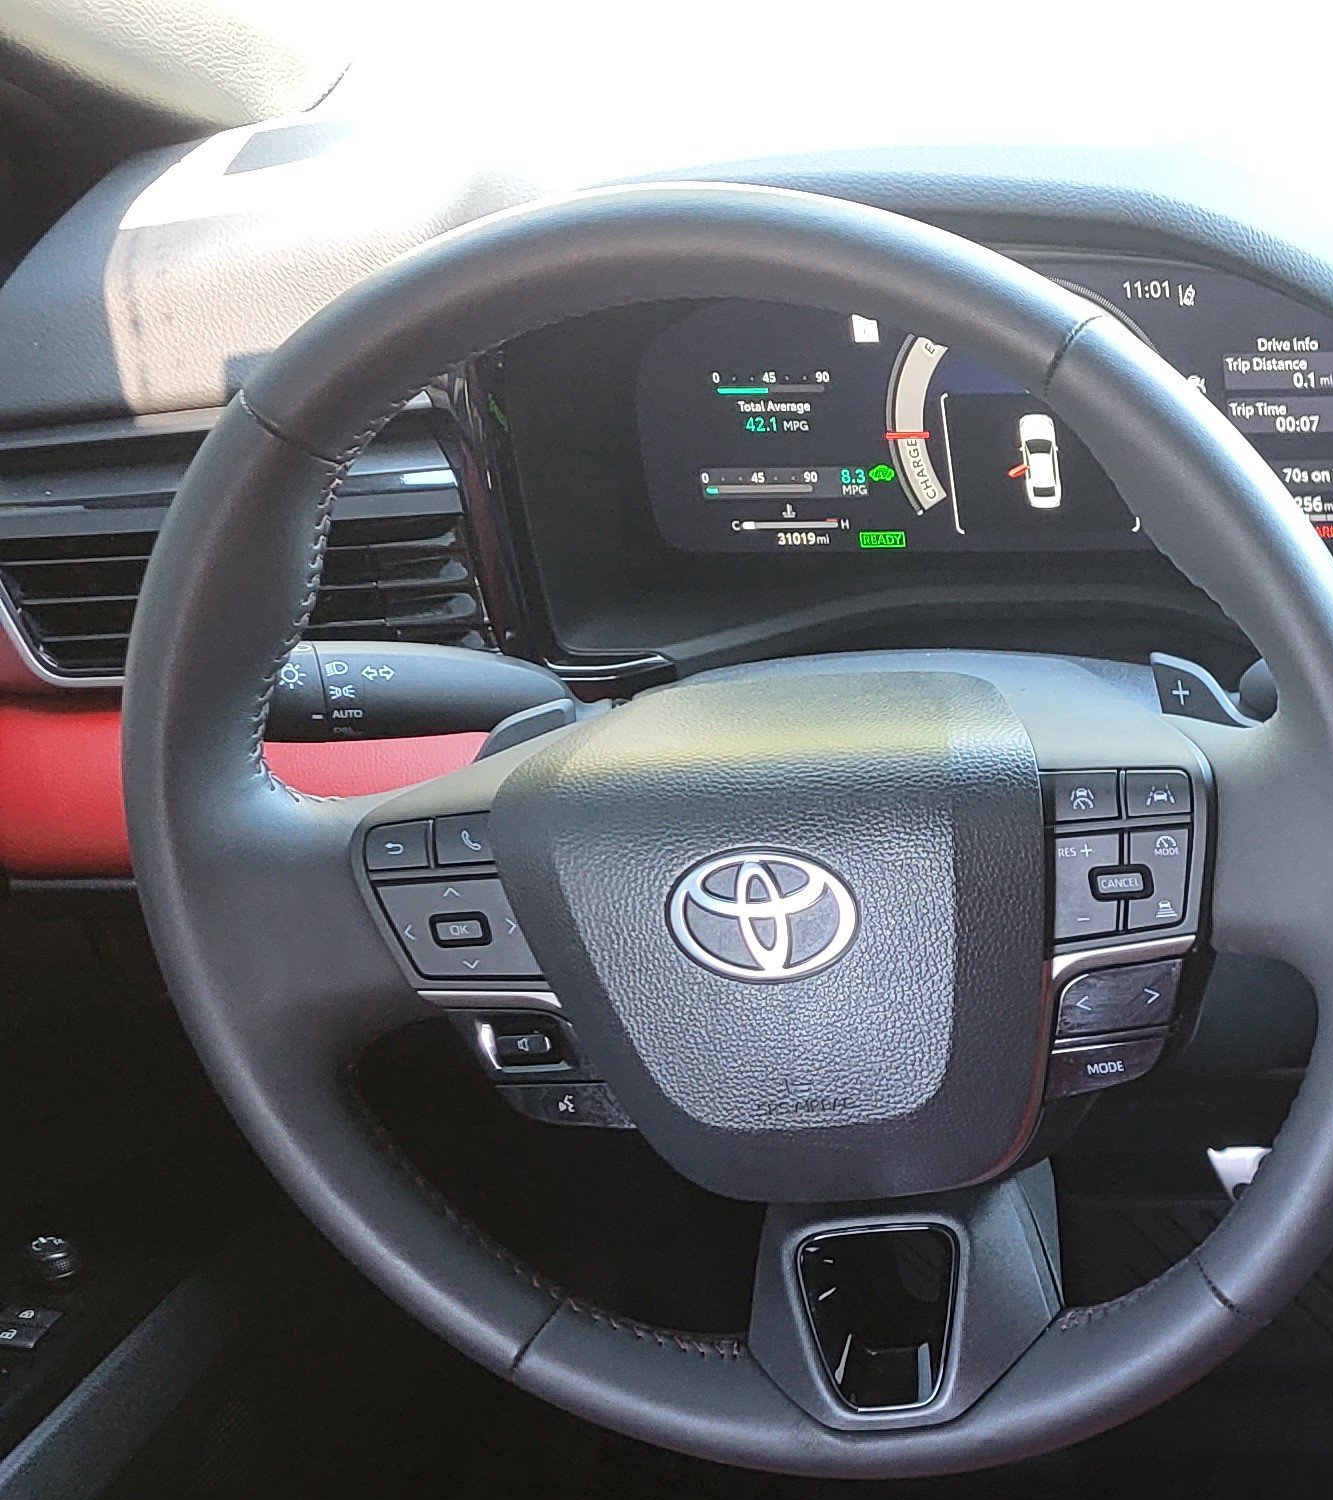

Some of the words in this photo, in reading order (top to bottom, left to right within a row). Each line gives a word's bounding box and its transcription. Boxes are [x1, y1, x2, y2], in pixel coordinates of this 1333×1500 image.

[1123, 280, 1171, 299] 11:01
[1257, 338, 1290, 351] Drive
[1292, 338, 1319, 351] Info
[1225, 357, 1251, 372] Trip
[1252, 357, 1308, 371] Distance
[712, 373, 721, 384] 0
[762, 372, 777, 384] 45
[815, 371, 830, 383] 90
[1293, 372, 1316, 388] 0.1
[738, 401, 765, 412] Total
[767, 401, 811, 414] Average
[1229, 402, 1253, 417] Trip
[1254, 402, 1287, 416] Time
[745, 417, 778, 432] 42.1
[783, 420, 809, 432] MPG
[1275, 416, 1320, 432] 00:07
[907, 439, 937, 500] CHARGE
[1282, 468, 1309, 484] 70s
[1312, 471, 1331, 483] on
[702, 473, 710, 484] 0
[751, 472, 765, 484] 45
[803, 471, 818, 483] 90
[840, 469, 866, 484] 8.3
[842, 485, 868, 496] MPG
[731, 520, 741, 531] C
[840, 519, 850, 530] H
[862, 534, 902, 546] READY
[331, 709, 364, 719] AUTO
[1058, 847, 1077, 858] RES
[1154, 846, 1180, 857] MODE
[1100, 876, 1140, 889] CANCEL
[449, 924, 469, 937] OK
[1087, 1060, 1125, 1076] MODE
